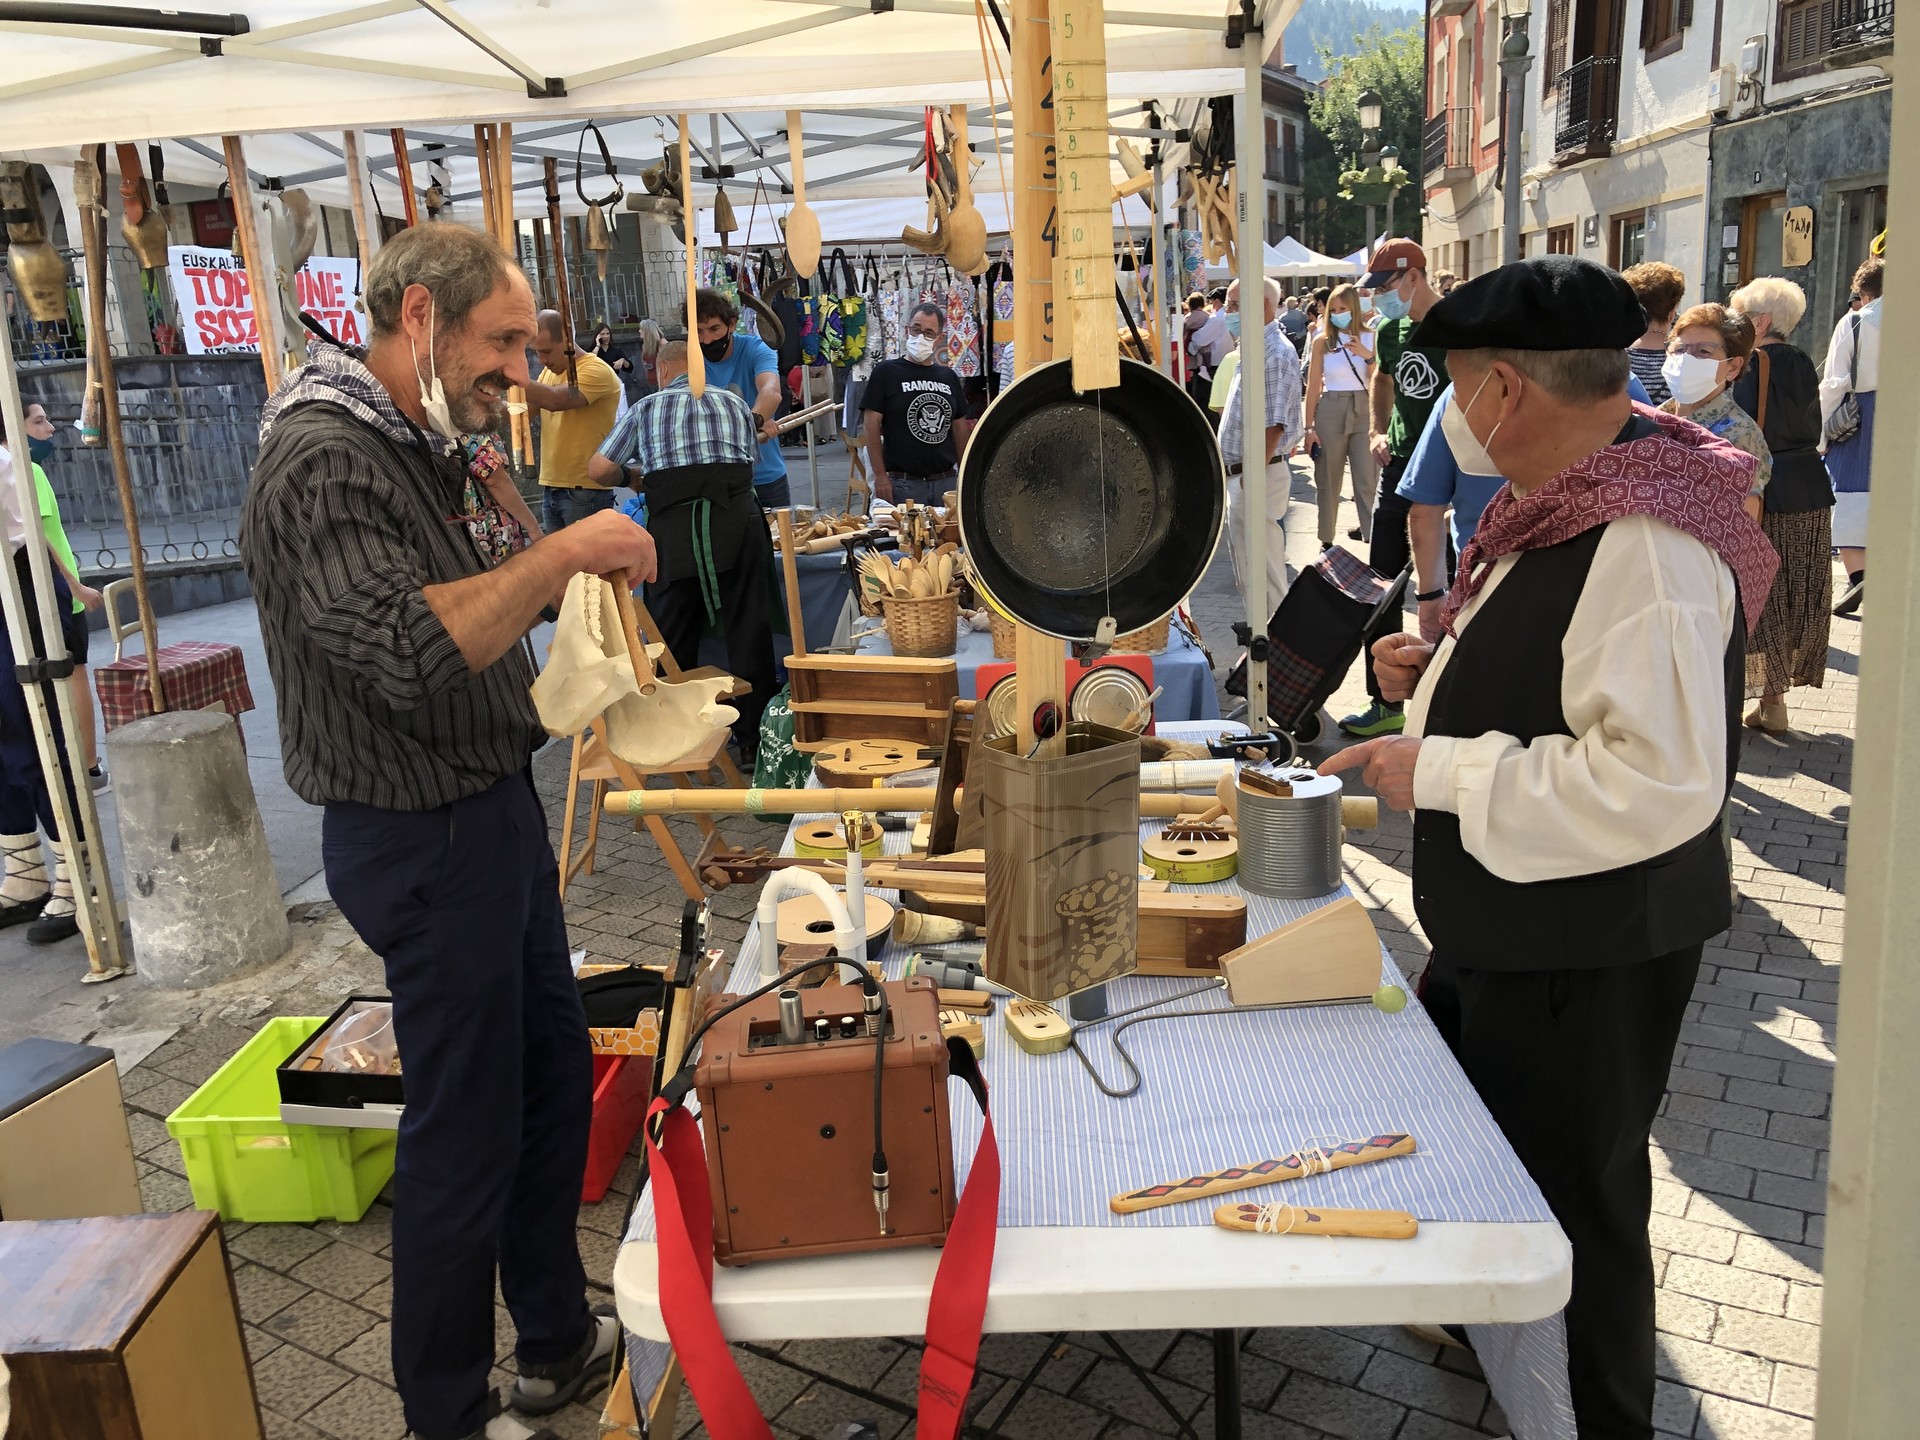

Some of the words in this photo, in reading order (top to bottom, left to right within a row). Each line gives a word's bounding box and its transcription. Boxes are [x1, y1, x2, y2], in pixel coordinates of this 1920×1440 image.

[1064, 13, 1074, 39] 5
[1066, 72, 1074, 88] 6
[1066, 106, 1076, 121] 7
[1068, 134, 1077, 151] 8
[1043, 145, 1057, 179] 3
[1041, 206, 1059, 258] 4
[1072, 228, 1083, 243] 10
[182, 254, 232, 270] EUSKAL
[901, 380, 952, 395] RAMONES
[917, 393, 947, 407] JOHNNY
